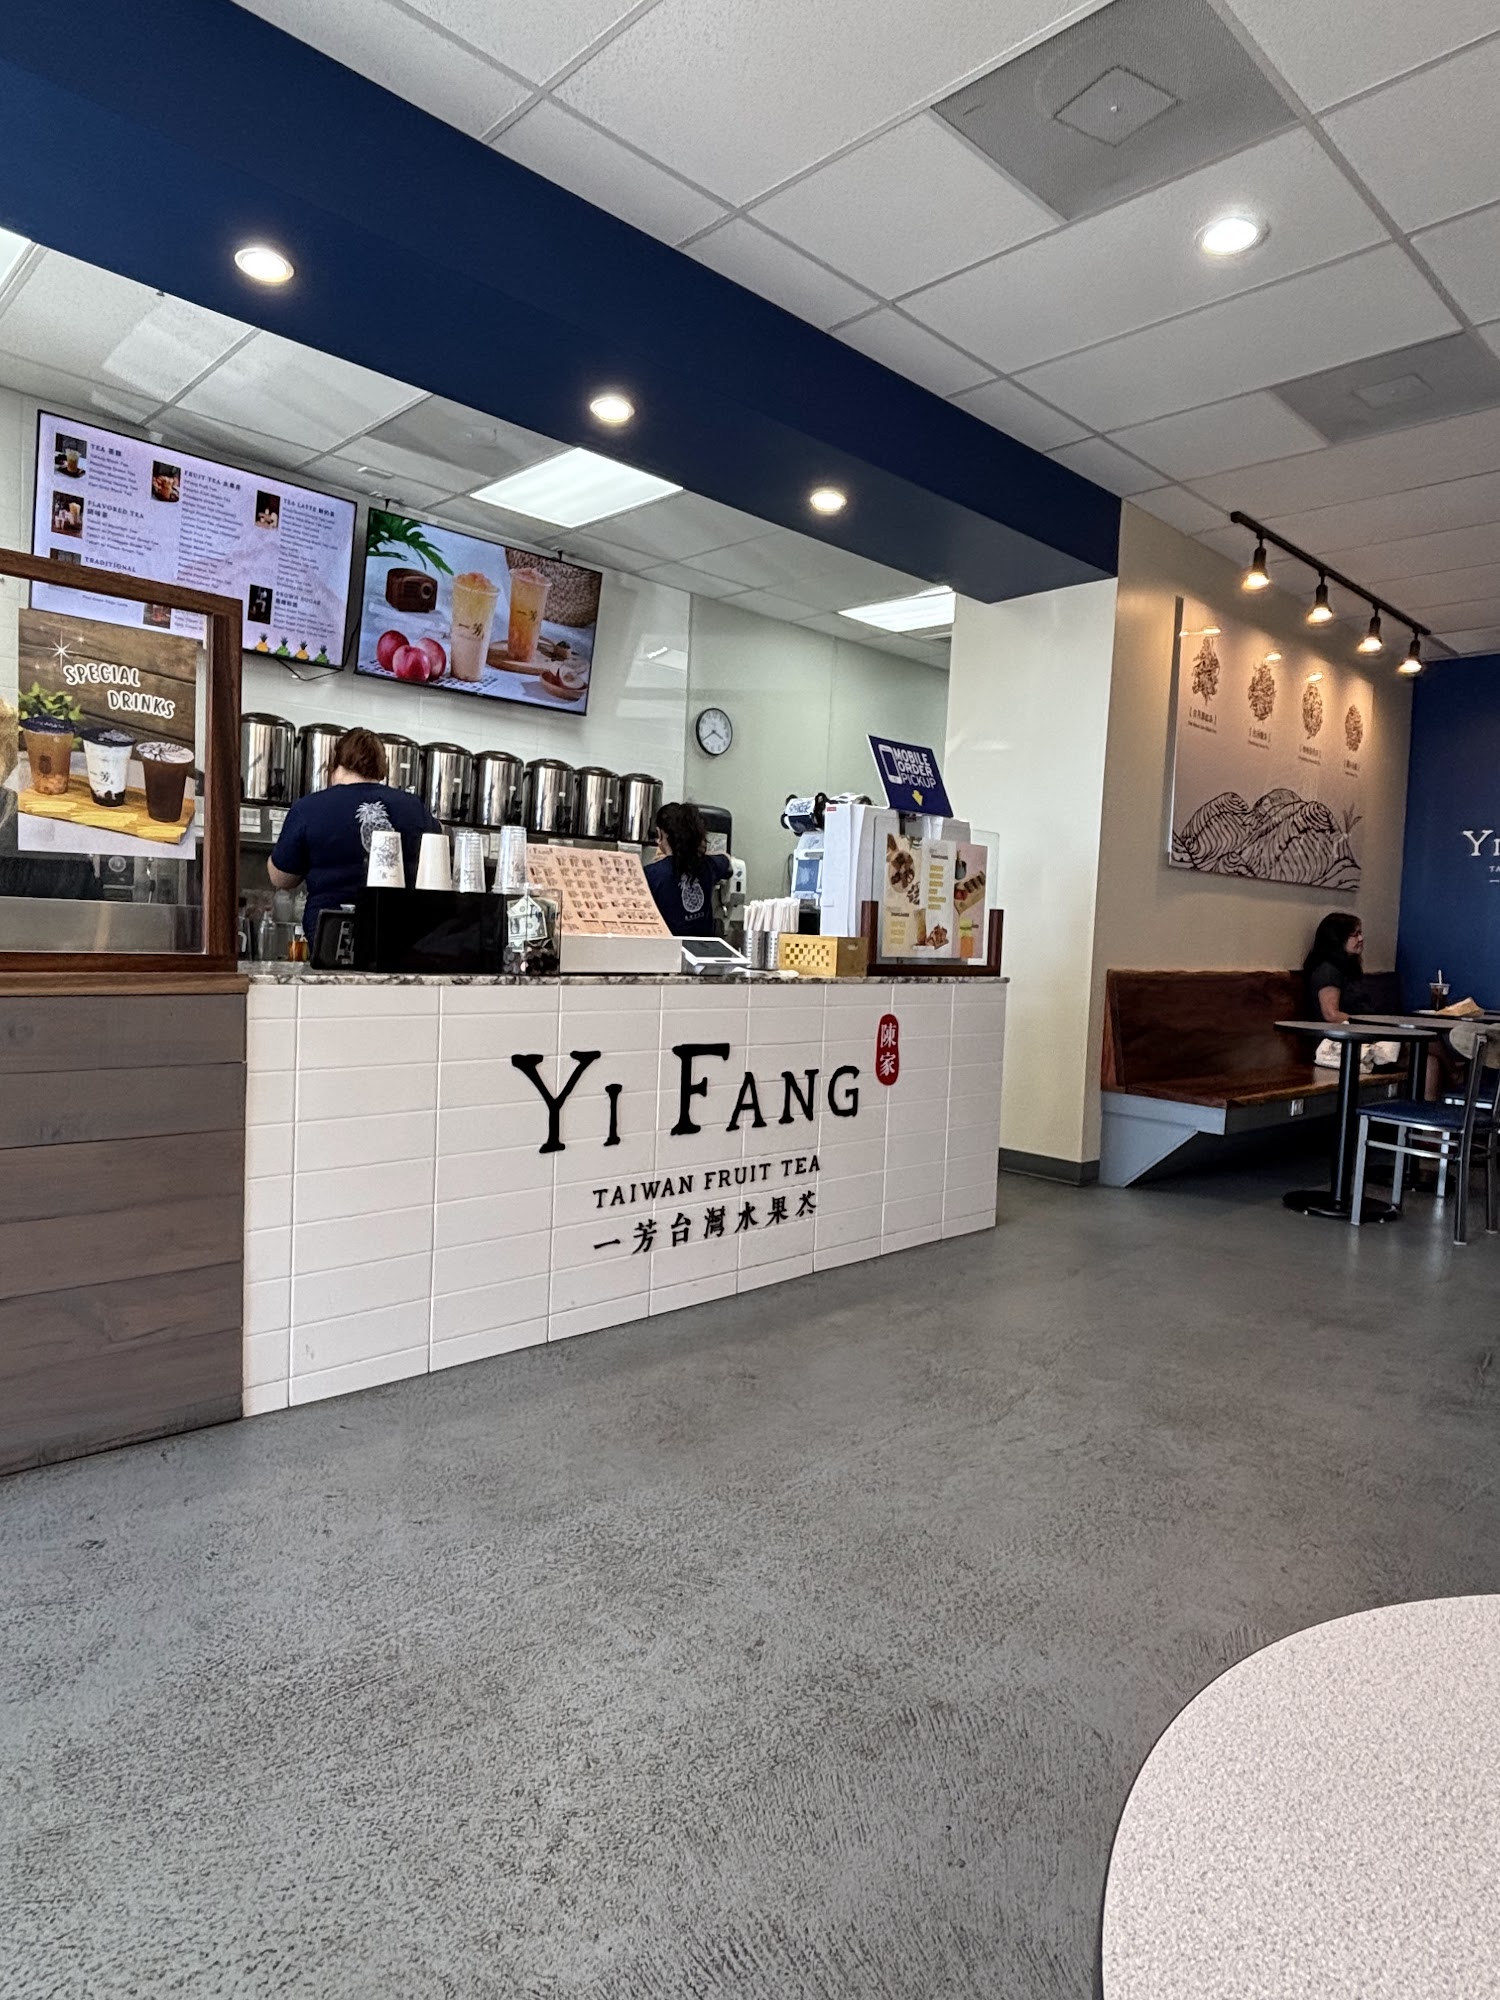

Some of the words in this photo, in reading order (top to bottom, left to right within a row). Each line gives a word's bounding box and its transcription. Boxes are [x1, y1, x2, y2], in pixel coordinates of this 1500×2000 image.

[90, 443, 105, 453] TEA
[184, 470, 205, 481] FRUIT
[207, 476, 221, 485] TEA
[87, 499, 128, 515] FLAVORED
[129, 510, 144, 519] TEA
[283, 498, 295, 507] TEA
[84, 556, 137, 573] TRADITIONAL
[63, 663, 141, 687] SPECIAL
[107, 690, 175, 719] DRINKS
[893, 747, 930, 767] MOBILE
[898, 761, 934, 778] ORDER
[901, 772, 937, 789] PICKUP
[879, 1022, 897, 1077] 陳家
[671, 1042, 860, 1137] FANG
[593, 1174, 694, 1208] TAIWAN
[704, 1162, 772, 1190] FRUIT
[781, 1154, 821, 1177] TEA
[593, 1190, 818, 1255] 一芳台灣水果茶
